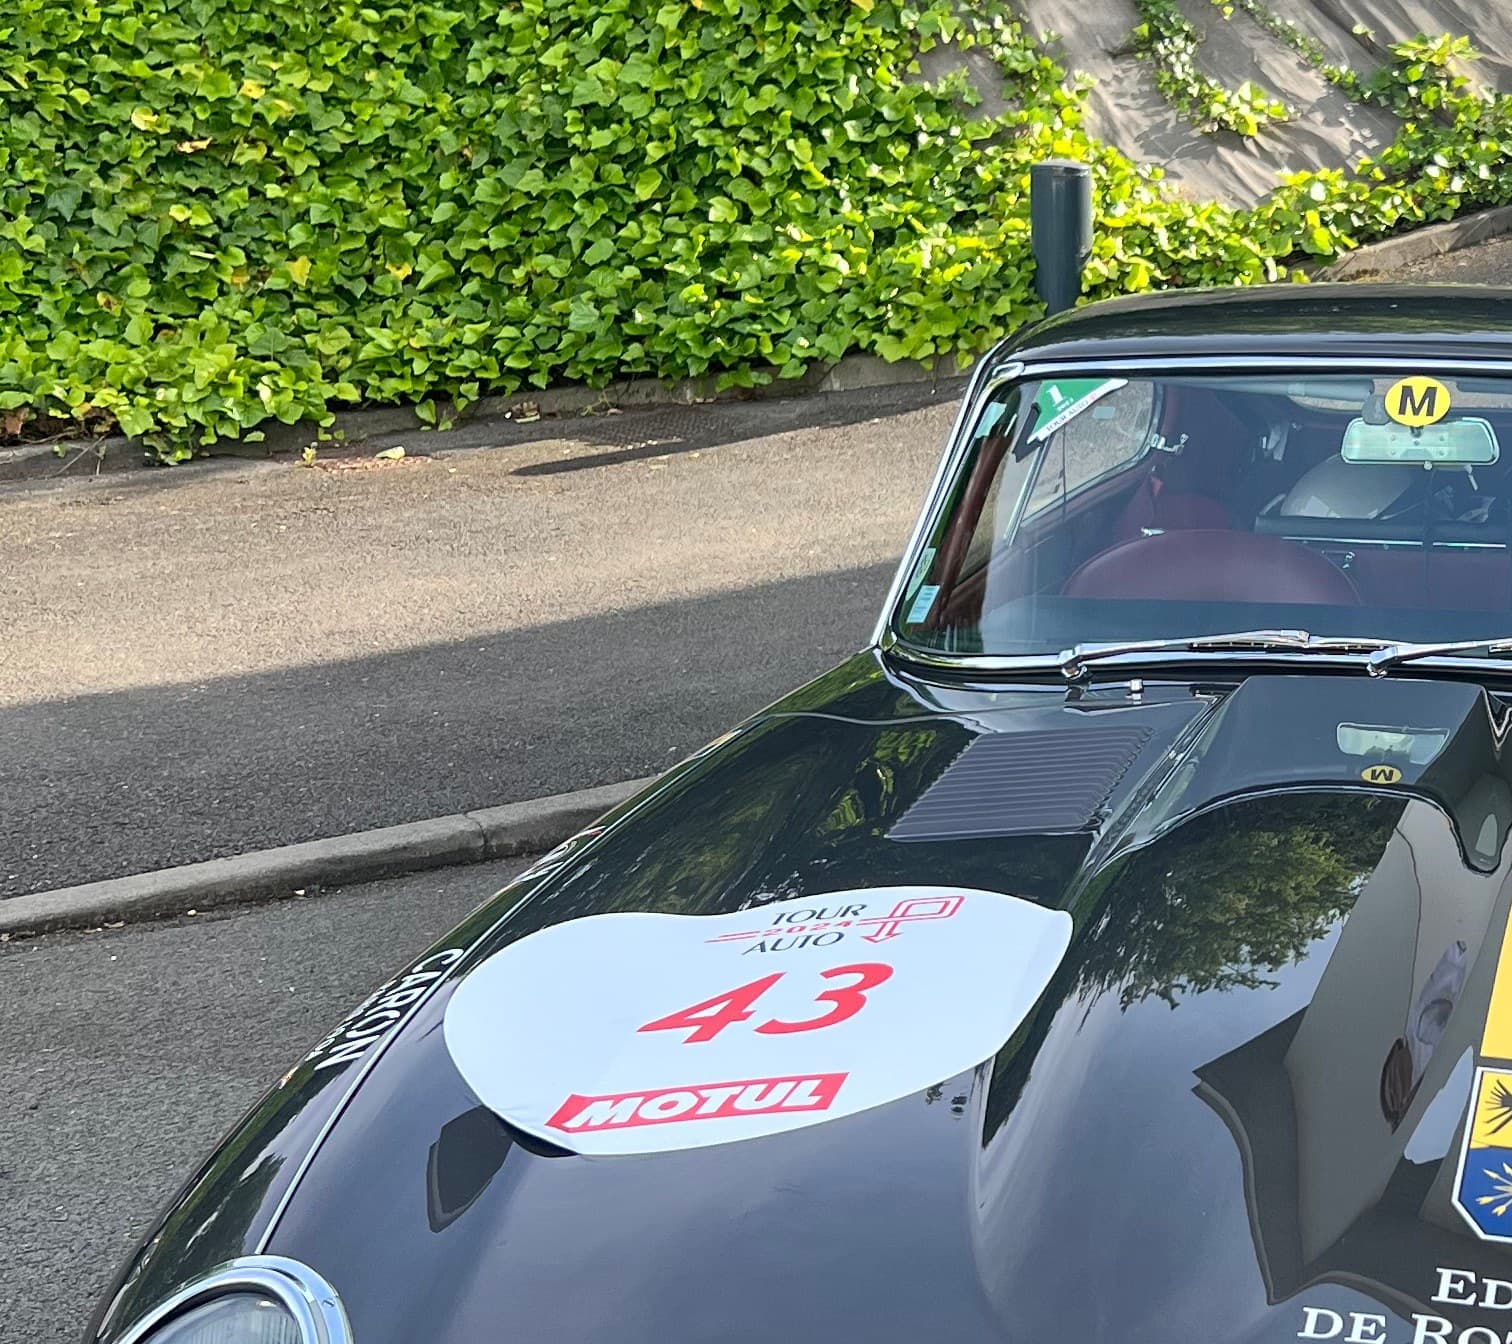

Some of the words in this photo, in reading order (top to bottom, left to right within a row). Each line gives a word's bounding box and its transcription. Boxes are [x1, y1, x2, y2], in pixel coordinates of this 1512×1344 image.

[1398, 385, 1437, 416] M
[762, 920, 853, 937] 2024
[772, 904, 868, 926] TOUR
[741, 931, 845, 955] AUTO
[314, 948, 464, 1071] CARON
[636, 962, 894, 1044] 43
[566, 1078, 824, 1132] MOTUL
